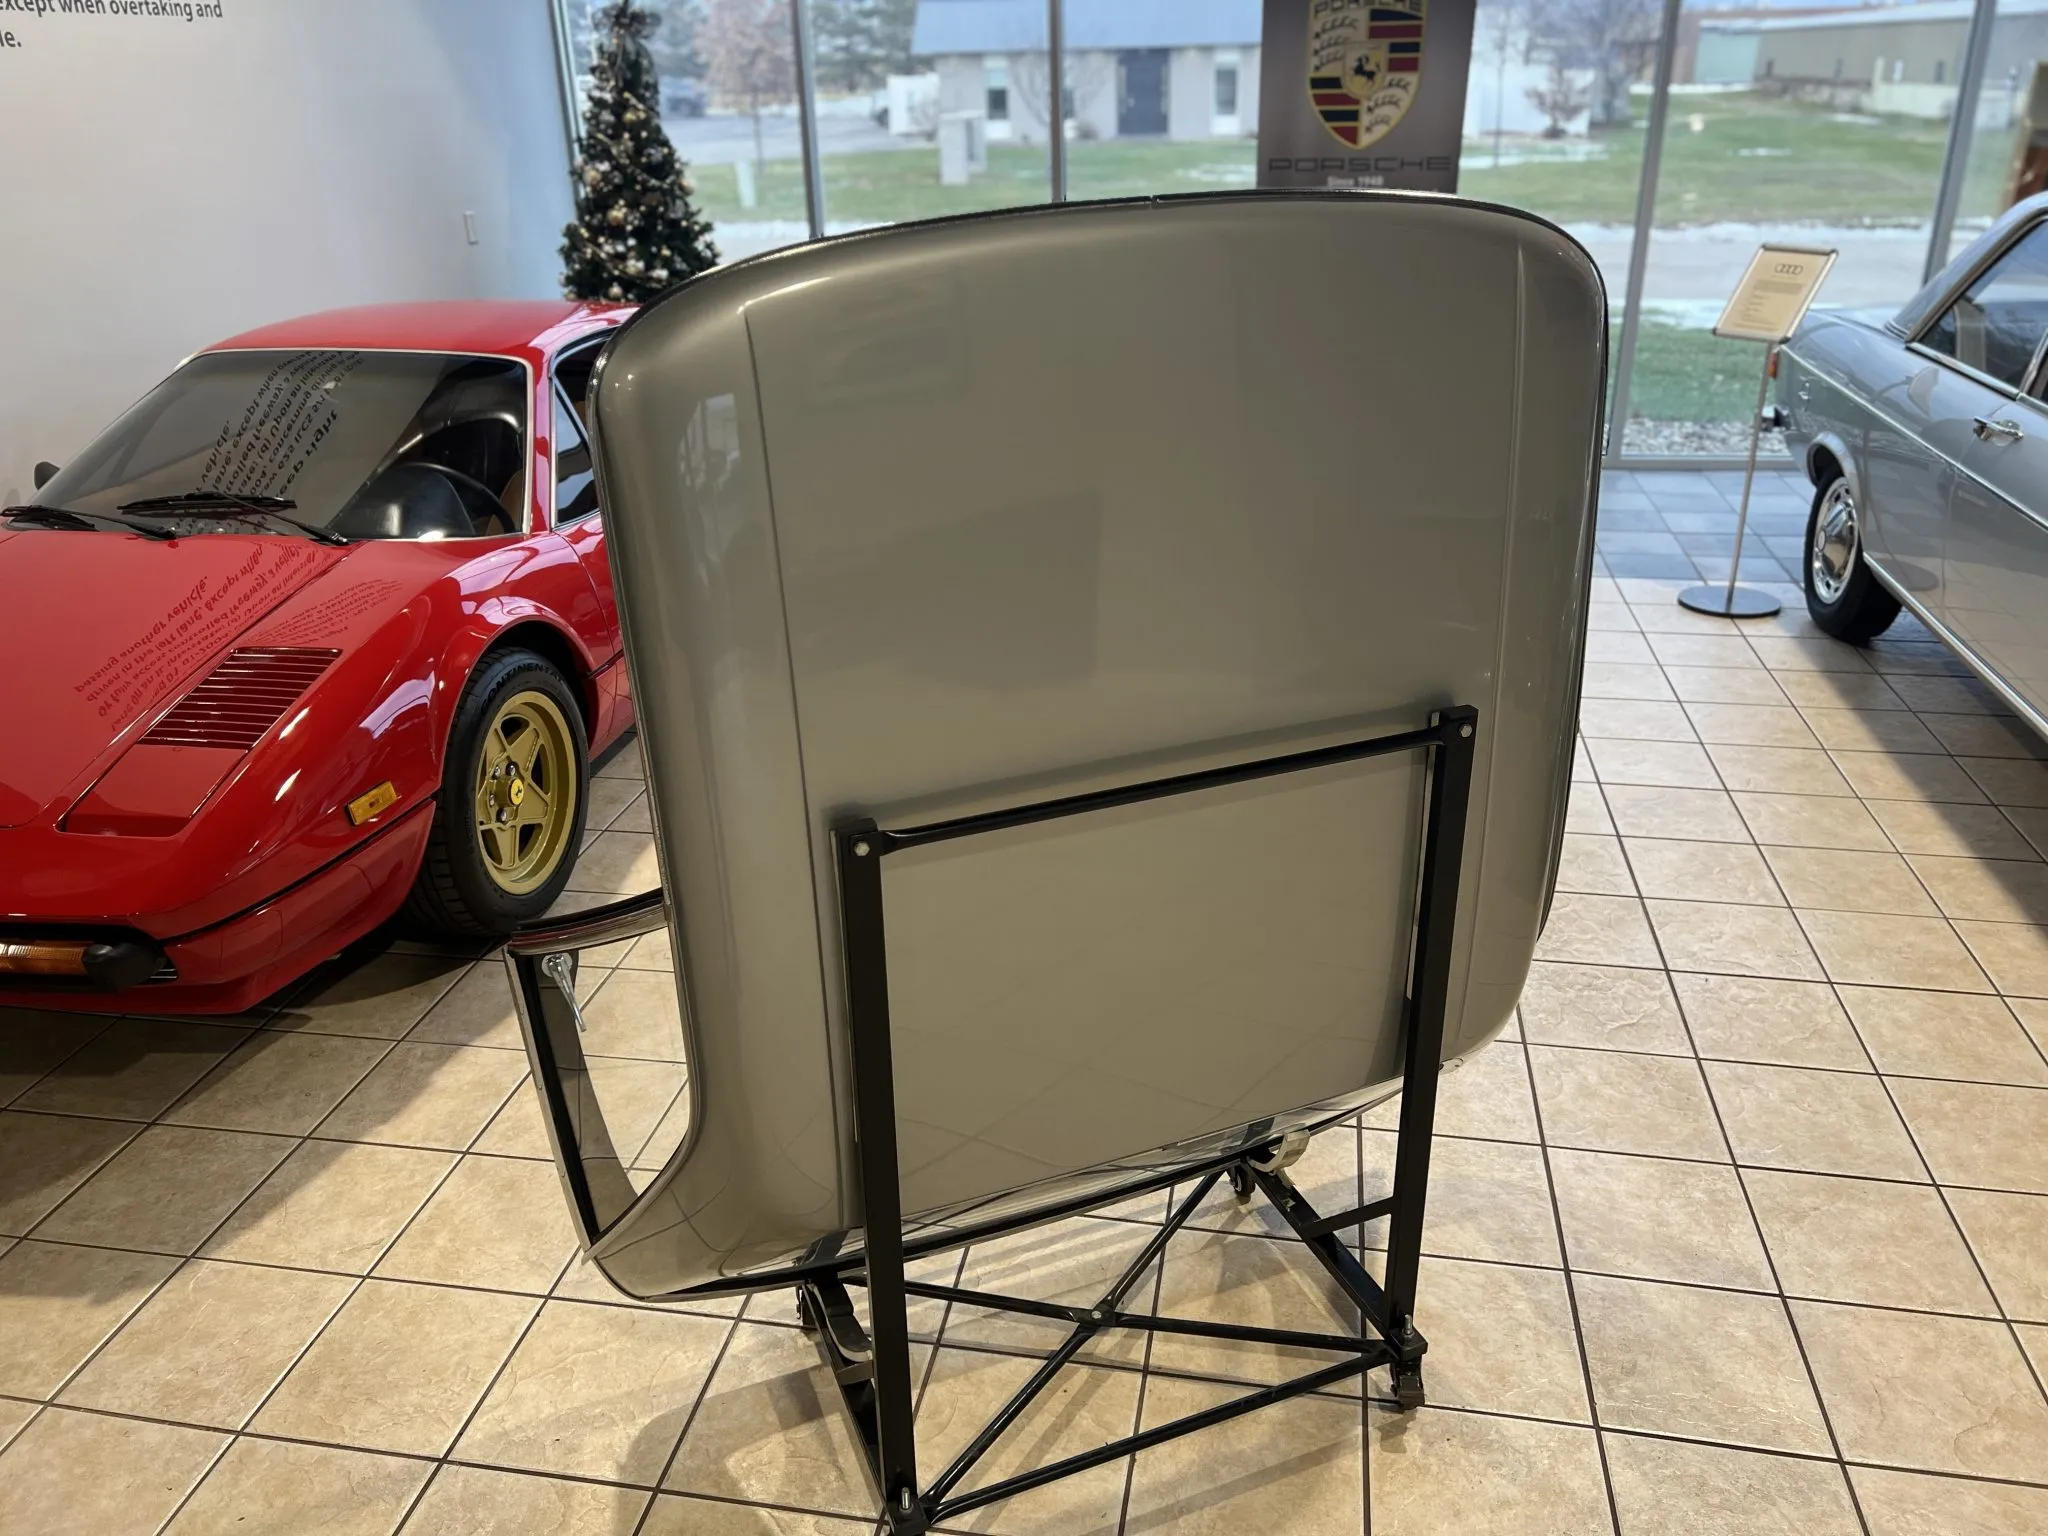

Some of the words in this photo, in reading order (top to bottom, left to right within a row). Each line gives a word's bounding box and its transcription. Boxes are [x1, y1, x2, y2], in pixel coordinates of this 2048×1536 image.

[0, 0, 55, 18] xcept
[58, 0, 106, 14] when
[110, 0, 194, 22] overtaking
[196, 0, 223, 18] and
[1269, 157, 1450, 173] PORSCHE
